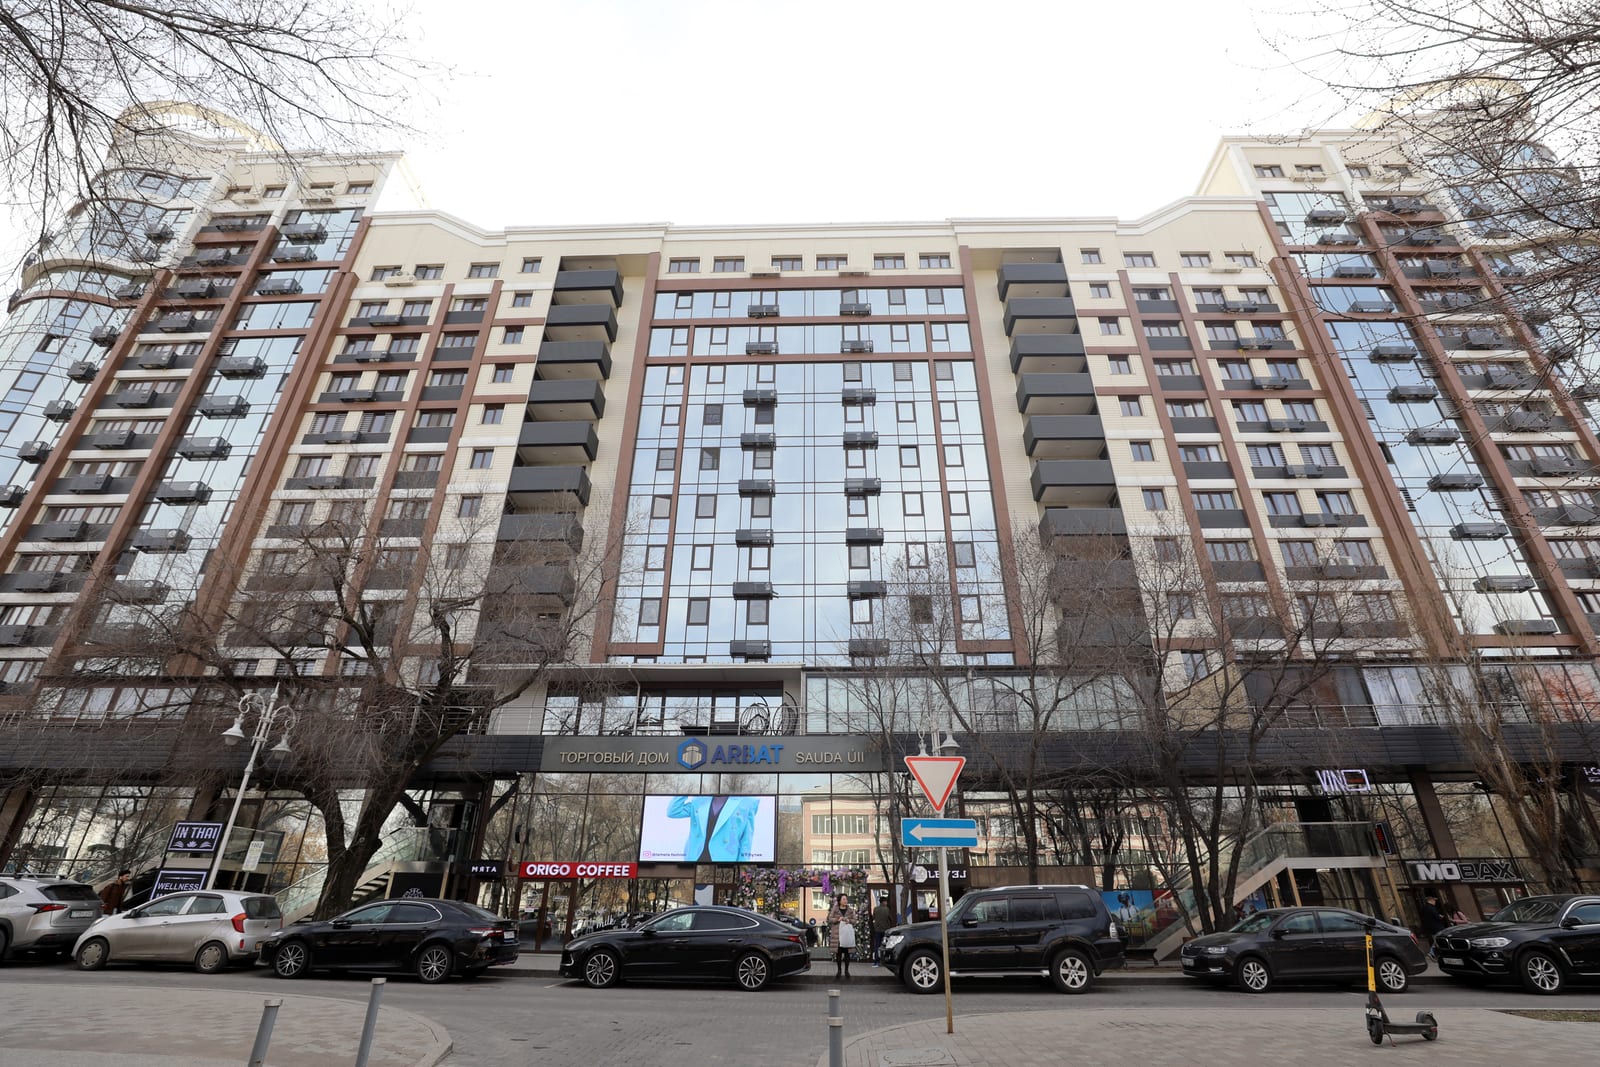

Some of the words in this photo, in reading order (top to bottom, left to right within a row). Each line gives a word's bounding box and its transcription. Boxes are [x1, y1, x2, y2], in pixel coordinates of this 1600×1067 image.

[559, 750, 634, 764] ТОРГОВЫЙ
[637, 752, 670, 766] ДОМ
[711, 744, 784, 765] ARBAT
[795, 751, 843, 764] SAUDA
[1315, 768, 1372, 792] VINCI
[175, 826, 189, 839] IN
[191, 827, 219, 840] THAI
[471, 865, 497, 874] МЯТА
[526, 864, 571, 876] ORIGO
[576, 864, 630, 877] COFFEE
[928, 870, 967, 879] LEEL
[1416, 862, 1518, 881] MOBAX
[157, 882, 200, 891] WELLNESS
